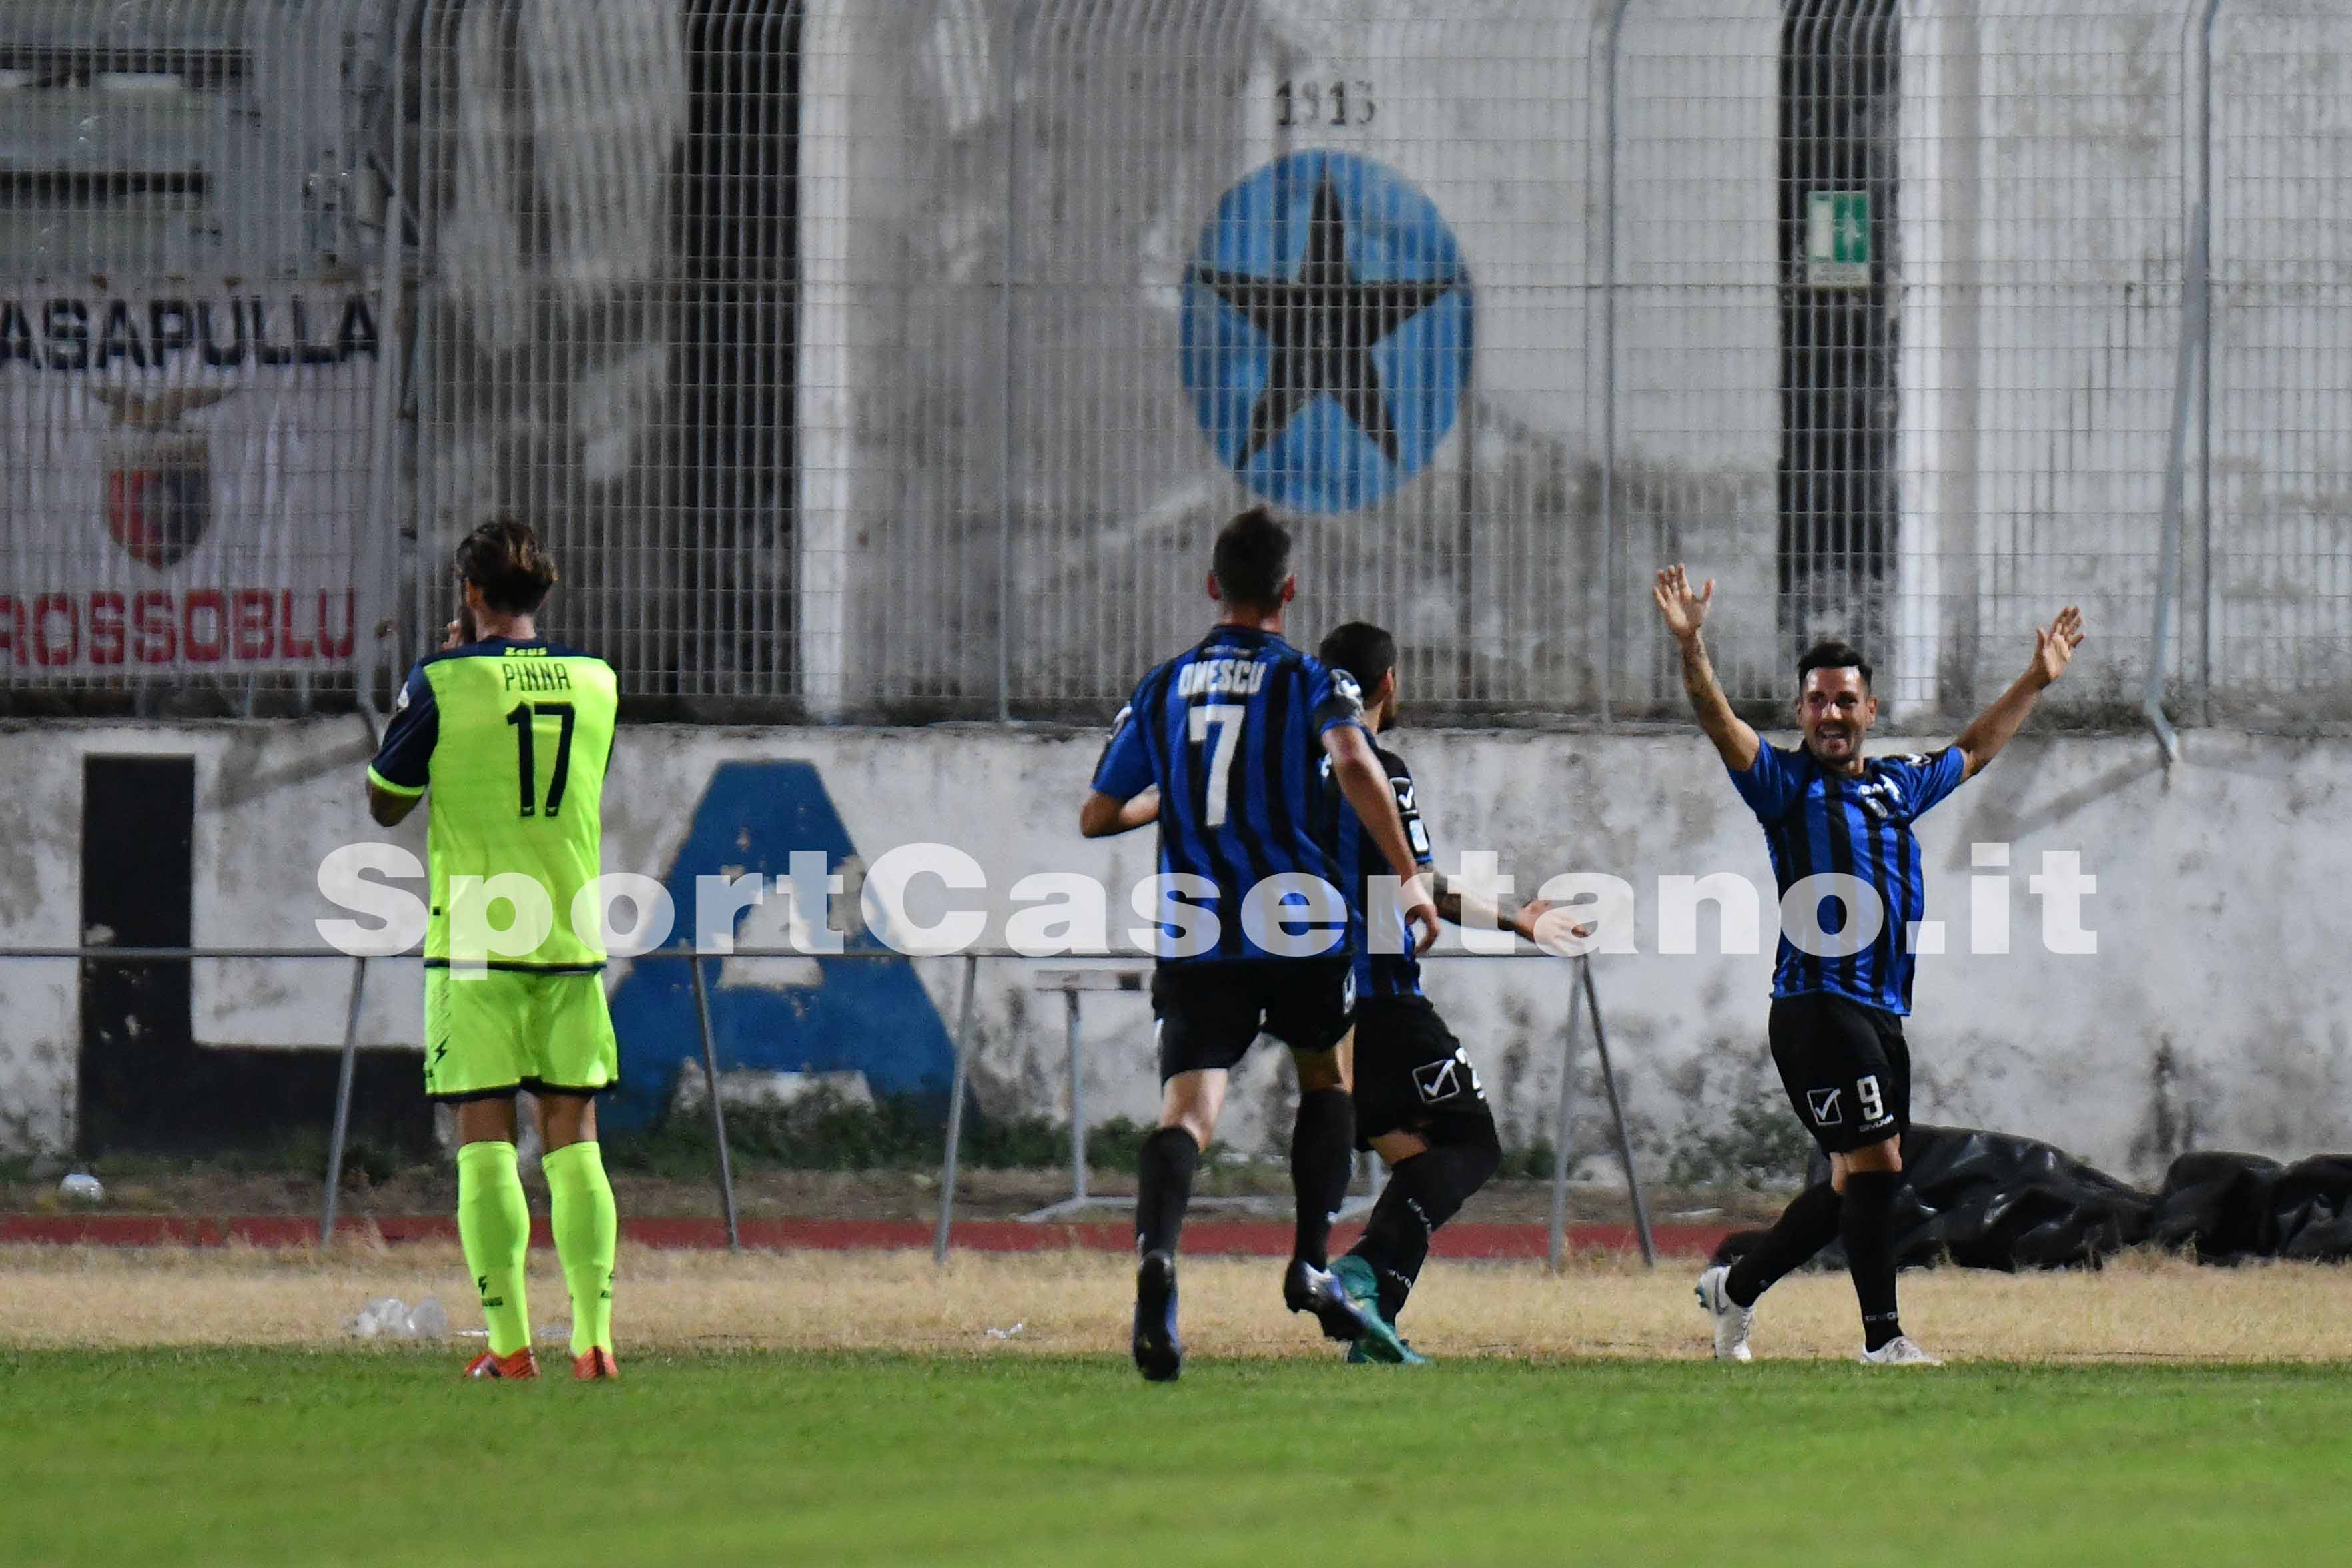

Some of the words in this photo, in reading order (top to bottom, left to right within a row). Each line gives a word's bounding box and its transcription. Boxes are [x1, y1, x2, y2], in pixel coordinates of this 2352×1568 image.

[1274, 80, 1376, 125] 1913
[502, 662, 572, 691] PINNA
[506, 700, 575, 817] 17
[1189, 703, 1246, 827] 7
[1856, 1074, 1884, 1120] 9
